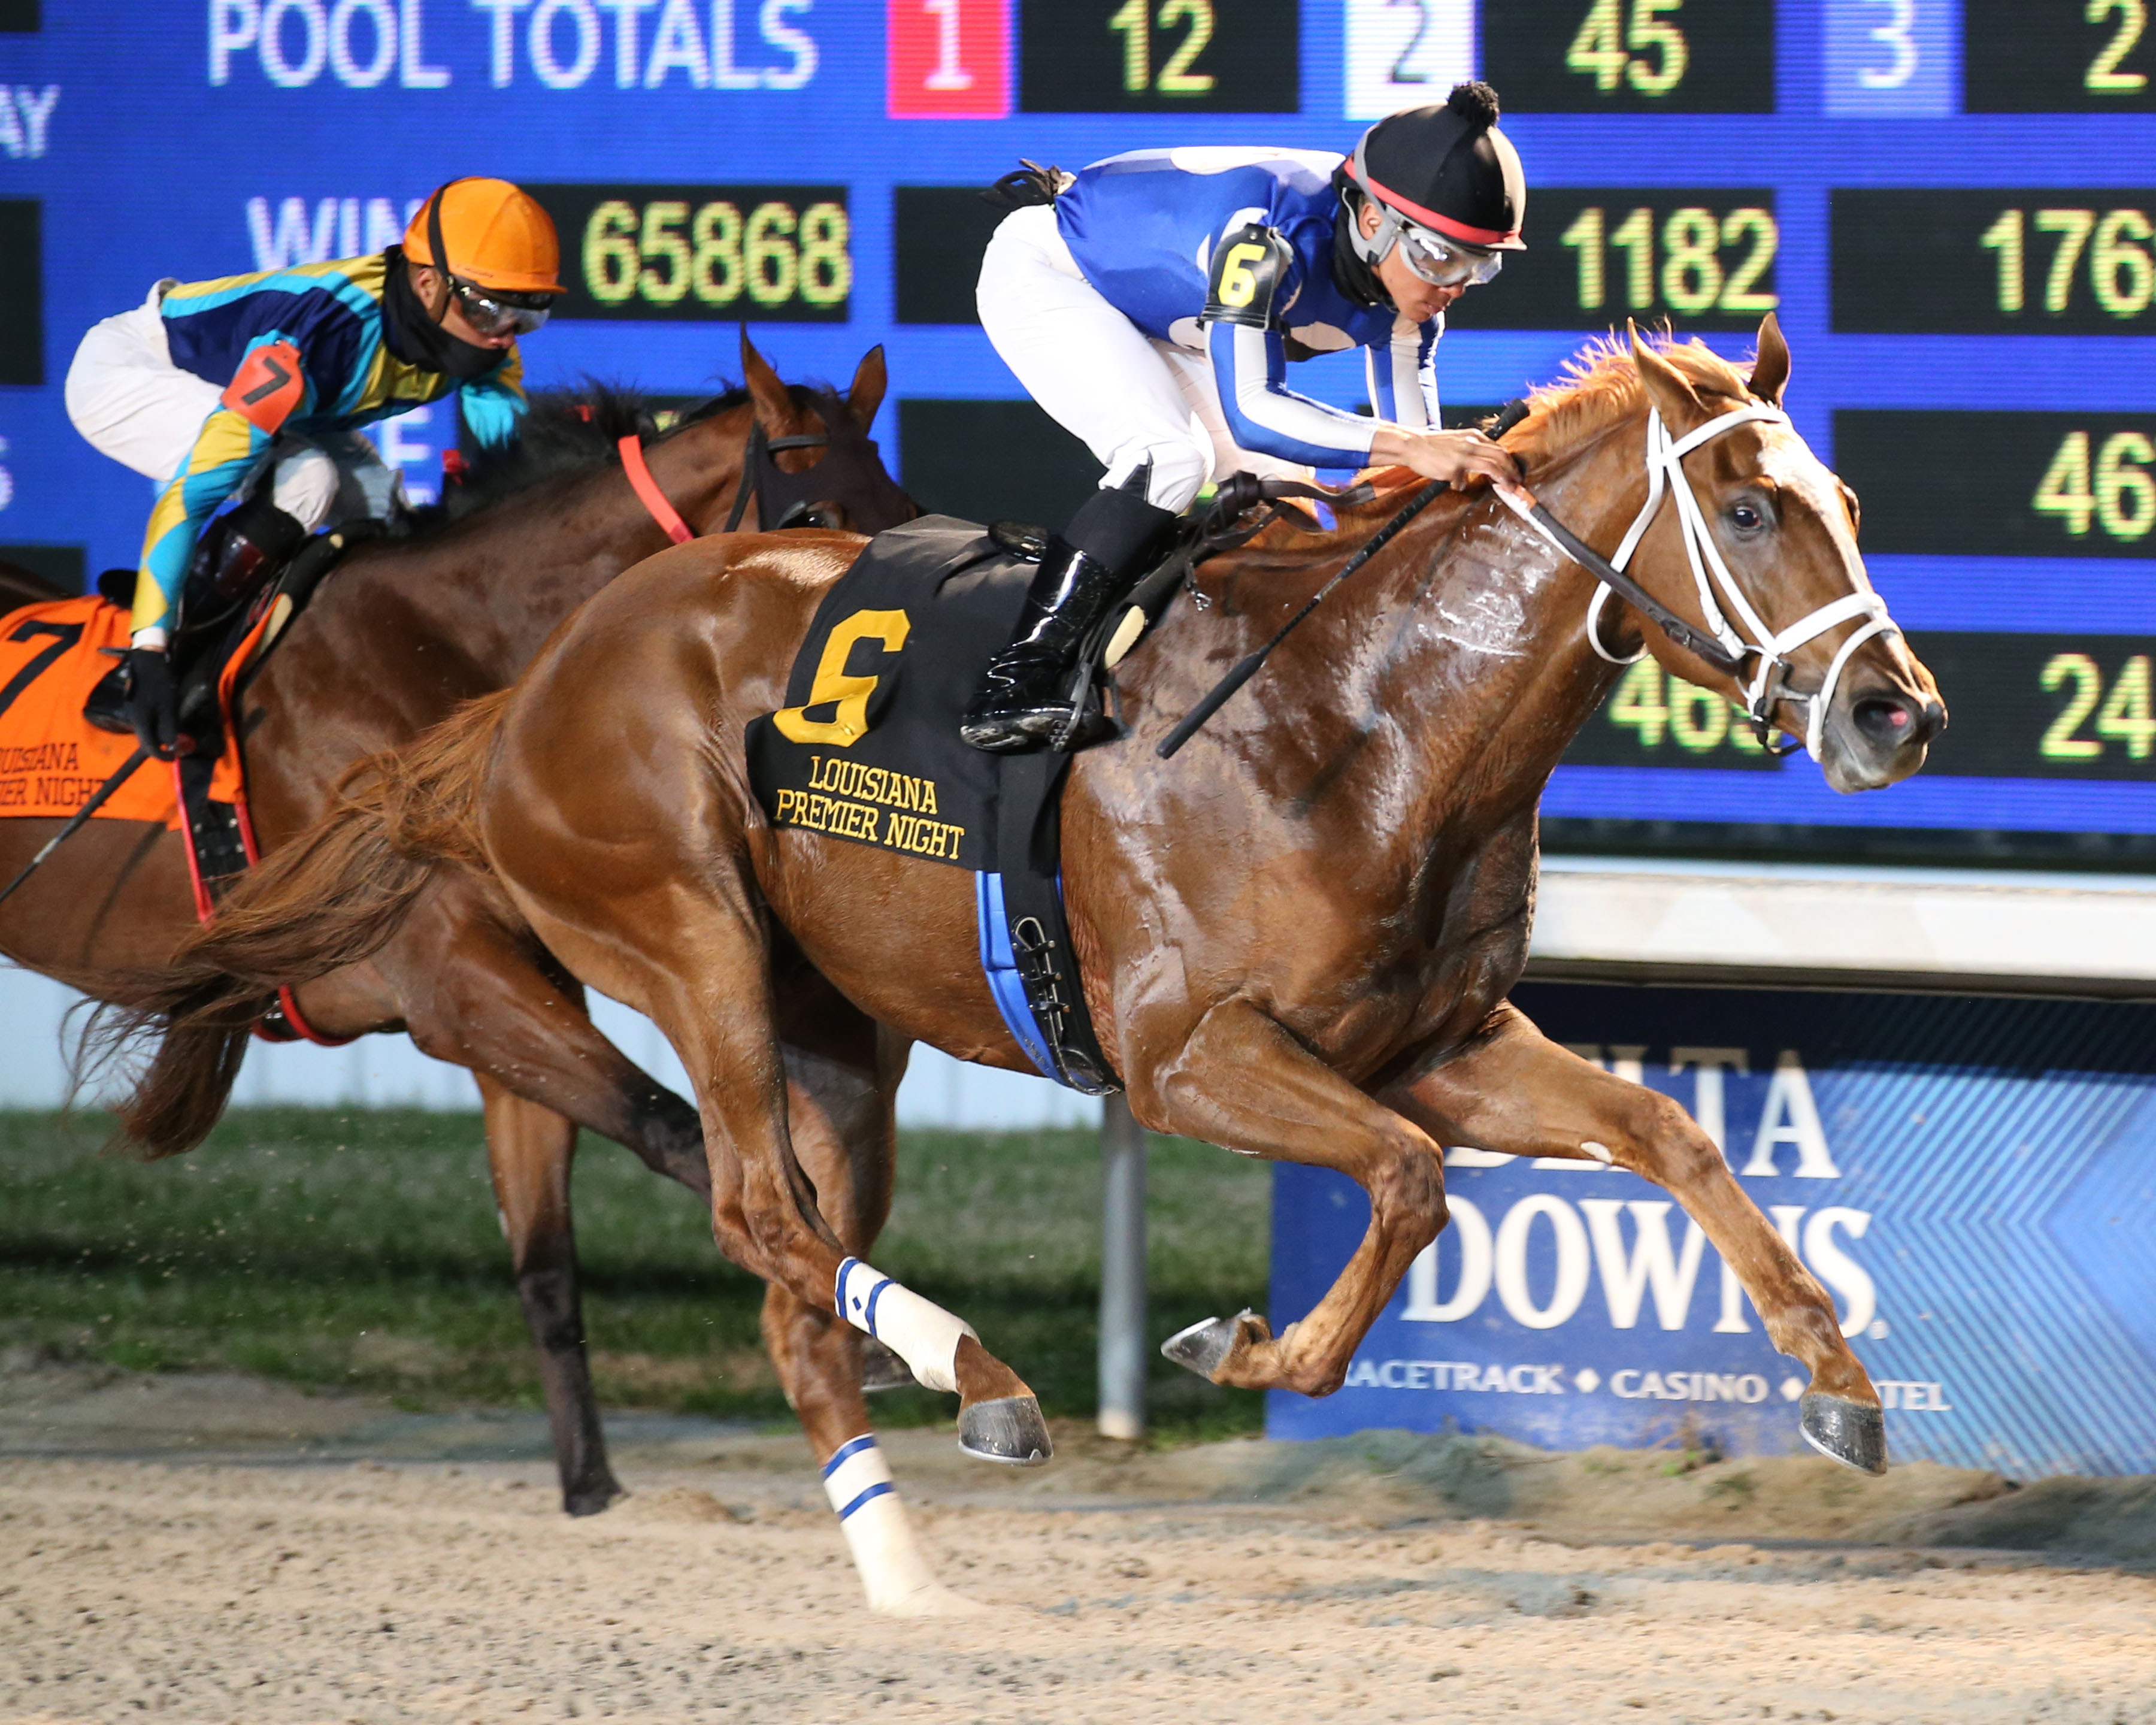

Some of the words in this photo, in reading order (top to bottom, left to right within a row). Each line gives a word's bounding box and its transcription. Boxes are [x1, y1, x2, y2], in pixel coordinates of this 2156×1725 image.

[208, 0, 452, 88] POOL
[472, 0, 819, 90] TOTALS
[924, 0, 974, 90] 1
[1108, 0, 1217, 92] 12
[1386, 0, 1428, 83] 2
[1565, 0, 1689, 92] 45
[1858, 0, 1916, 89] 3
[2084, 0, 2148, 90] 2
[582, 201, 853, 304] 65868
[1218, 243, 1265, 308] 6
[1561, 207, 1780, 313] 1182
[1979, 208, 2156, 315] 176
[242, 357, 290, 405] 7
[2031, 431, 2156, 540] 46
[0, 620, 86, 719] 7
[772, 608, 912, 748] 6
[2039, 652, 2156, 761] 24
[774, 789, 879, 842] PREMIER
[883, 812, 965, 860] NIGHT
[808, 755, 938, 815] LOUISIANA
[1344, 1359, 1564, 1395] ACETRACK
[1610, 1369, 1769, 1404] CASINO
[1870, 1379, 1953, 1412] TEL
